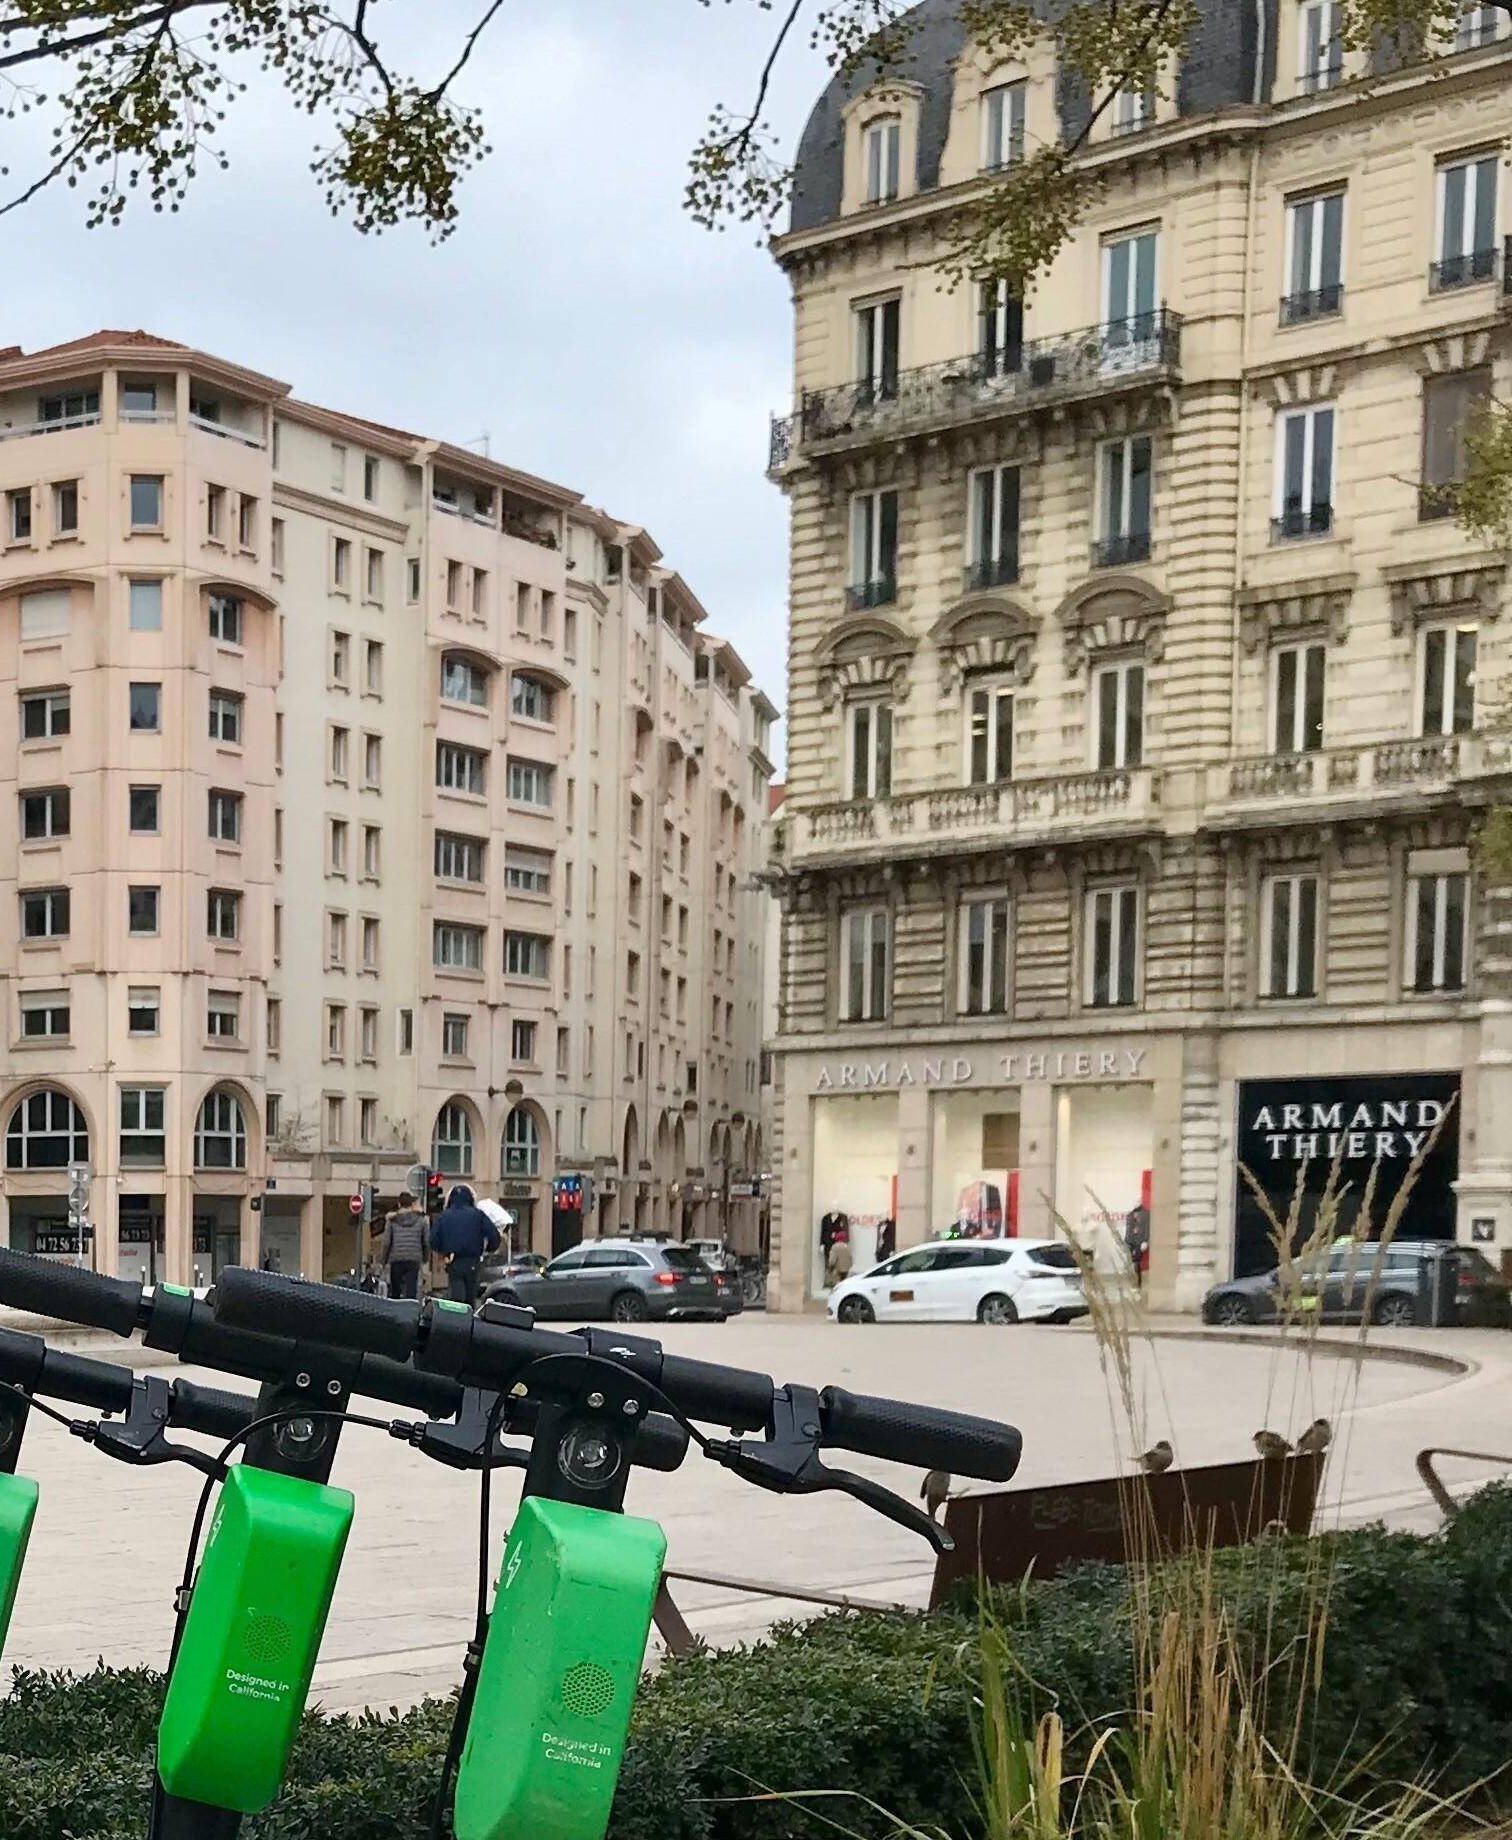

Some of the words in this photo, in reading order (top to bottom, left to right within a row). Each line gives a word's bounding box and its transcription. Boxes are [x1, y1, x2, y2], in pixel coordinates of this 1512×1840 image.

[816, 1057, 974, 1090] ARMAND
[999, 1049, 1146, 1082] THIERY
[1252, 1100, 1443, 1130] ARMAND
[1265, 1131, 1427, 1160] THIERY
[226, 1669, 276, 1689] Designed
[229, 1683, 281, 1702] California
[542, 1732, 598, 1753] Designed
[599, 1743, 612, 1756] in
[545, 1748, 602, 1769] California
